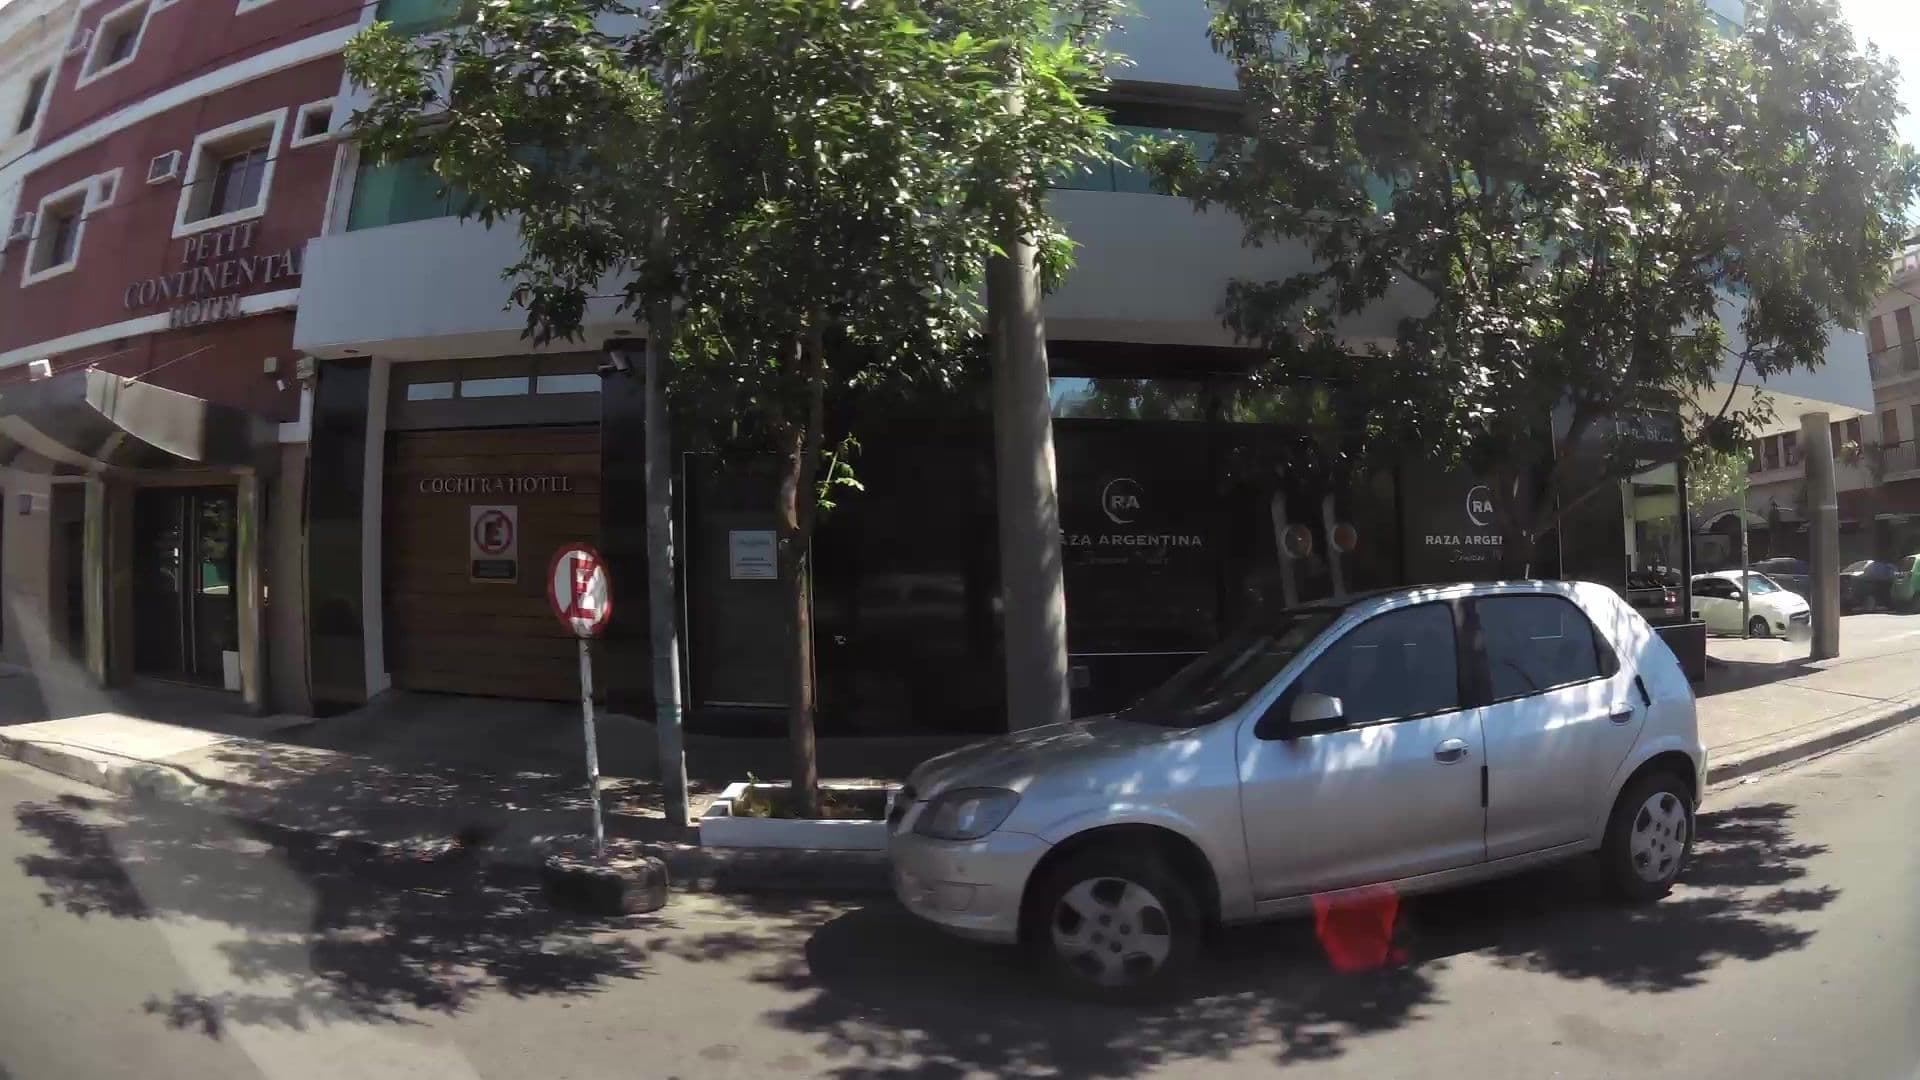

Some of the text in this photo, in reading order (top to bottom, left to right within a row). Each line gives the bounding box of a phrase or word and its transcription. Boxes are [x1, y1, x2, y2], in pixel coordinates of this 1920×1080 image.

[181, 220, 259, 264] PETIT
[169, 293, 241, 329] HOTEL
[508, 475, 573, 494] HOTEL
[1111, 495, 1141, 509] RA
[1472, 500, 1494, 513] RA
[484, 521, 503, 546] E
[1059, 534, 1203, 546] AZA ARGENTINA
[1425, 535, 1461, 545] RAZA
[569, 557, 596, 619] E
